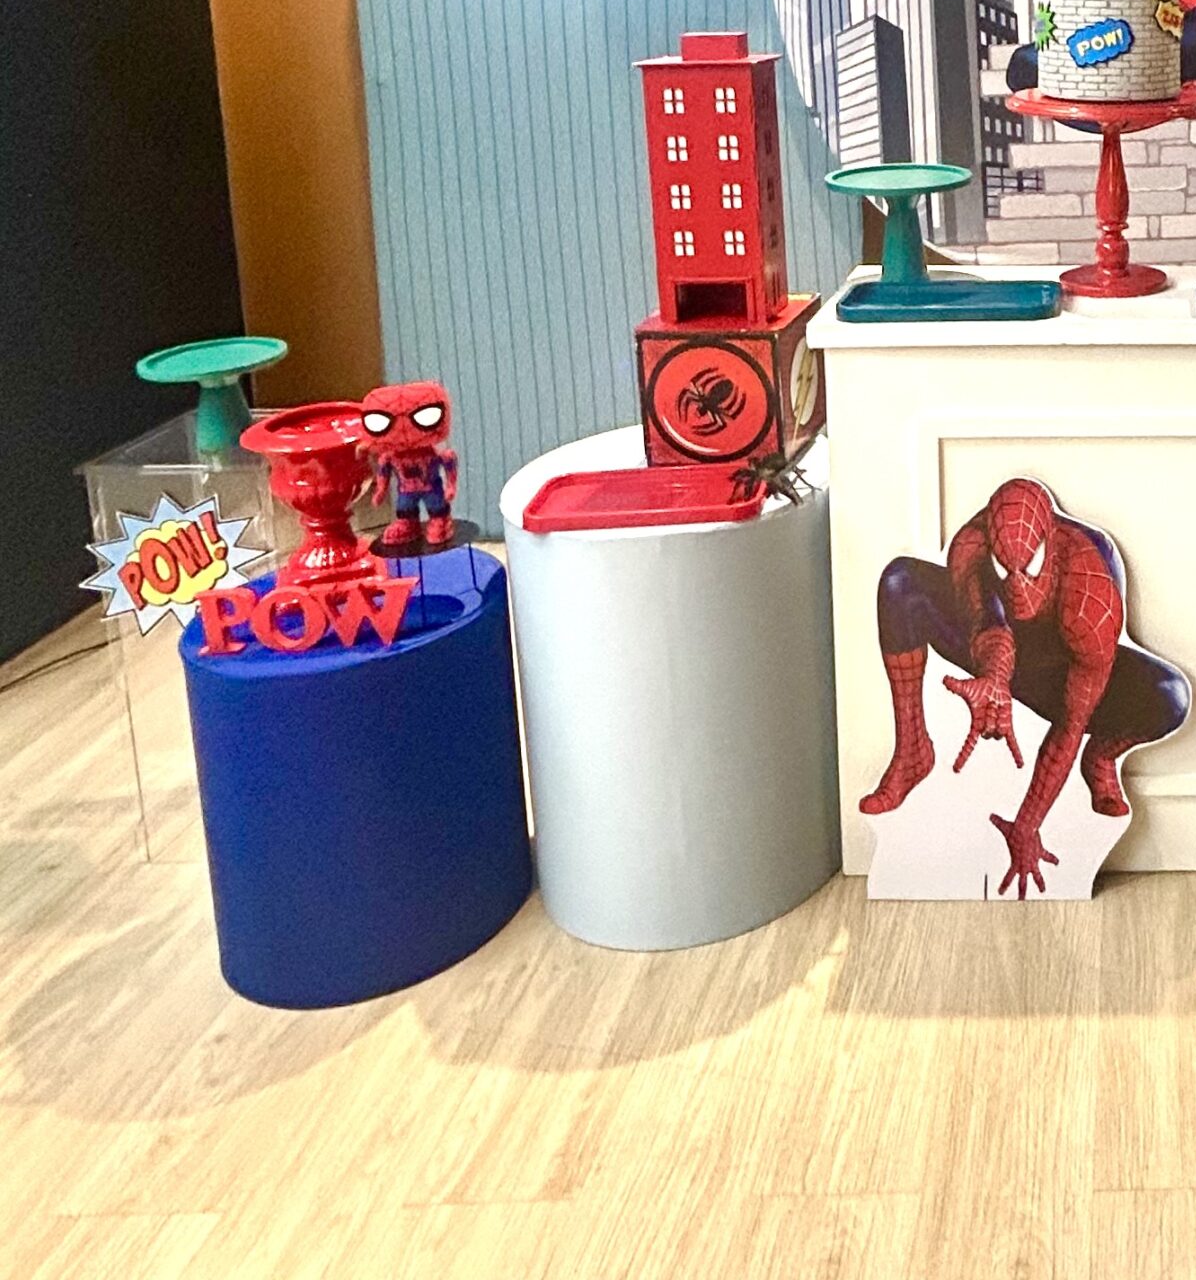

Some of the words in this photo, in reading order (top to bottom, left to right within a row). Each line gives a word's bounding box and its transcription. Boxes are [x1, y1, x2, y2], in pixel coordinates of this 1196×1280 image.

[1076, 28, 1123, 57] POW!
[117, 510, 228, 611] POW!
[193, 576, 421, 656] POW
